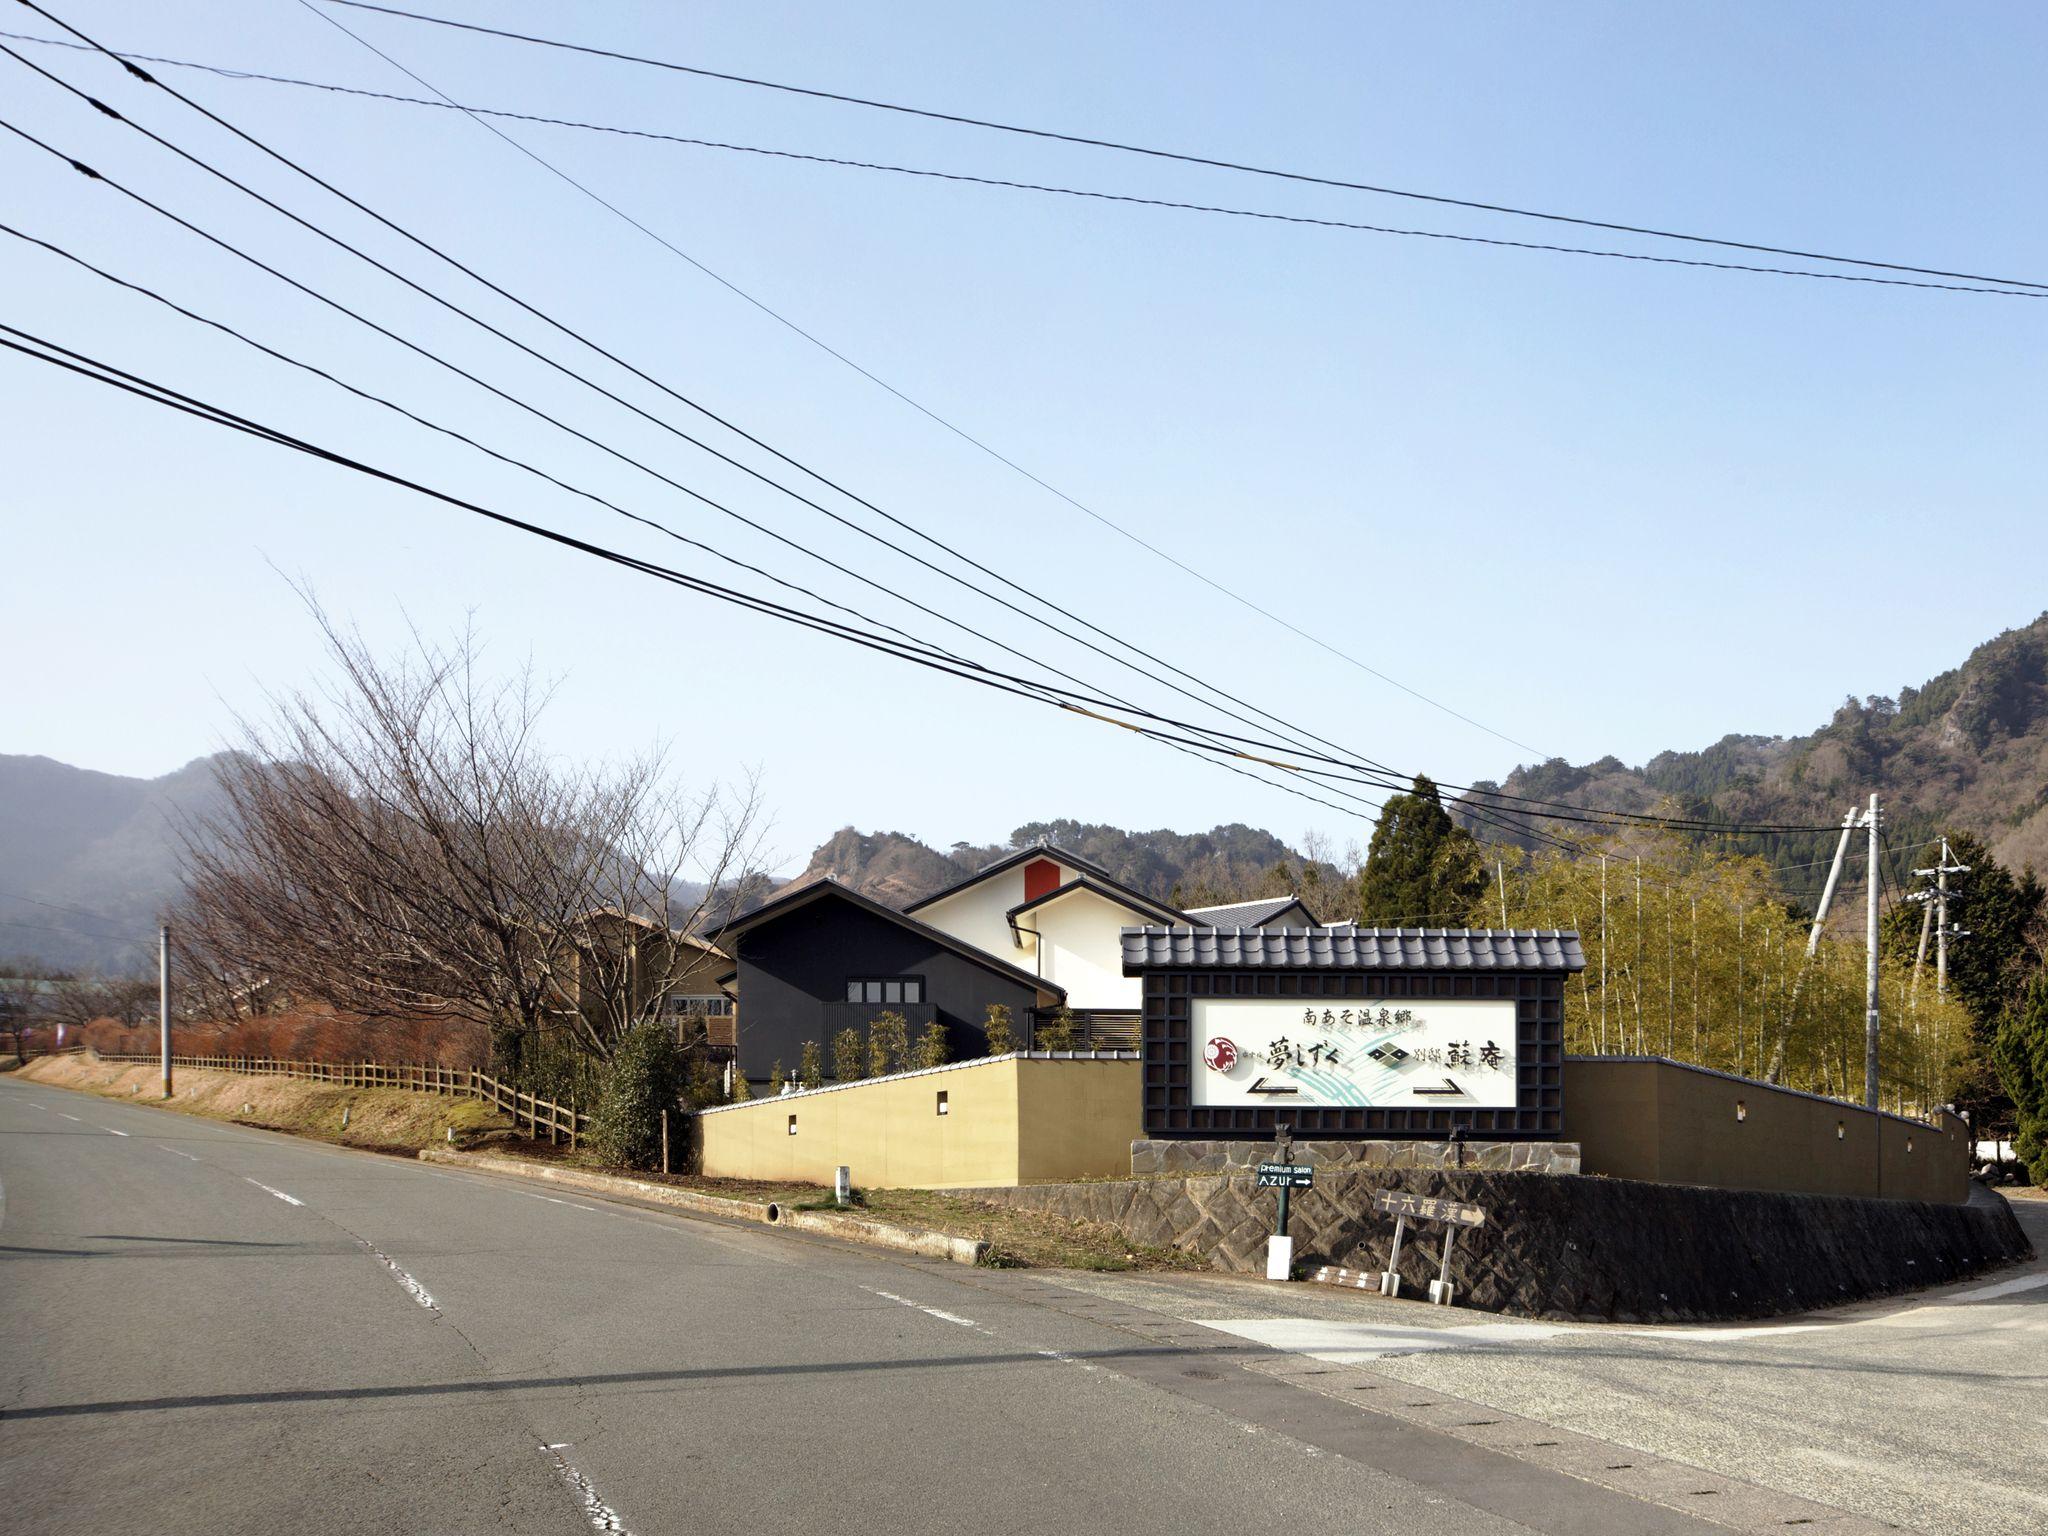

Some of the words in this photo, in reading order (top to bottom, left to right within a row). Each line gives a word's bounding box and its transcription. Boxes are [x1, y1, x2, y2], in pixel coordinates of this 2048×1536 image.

[1303, 1008, 1412, 1026] 南あそ温泉郷
[1267, 1036, 1339, 1070] 夢しずく
[1381, 1192, 1459, 1223] 十六羅漢
